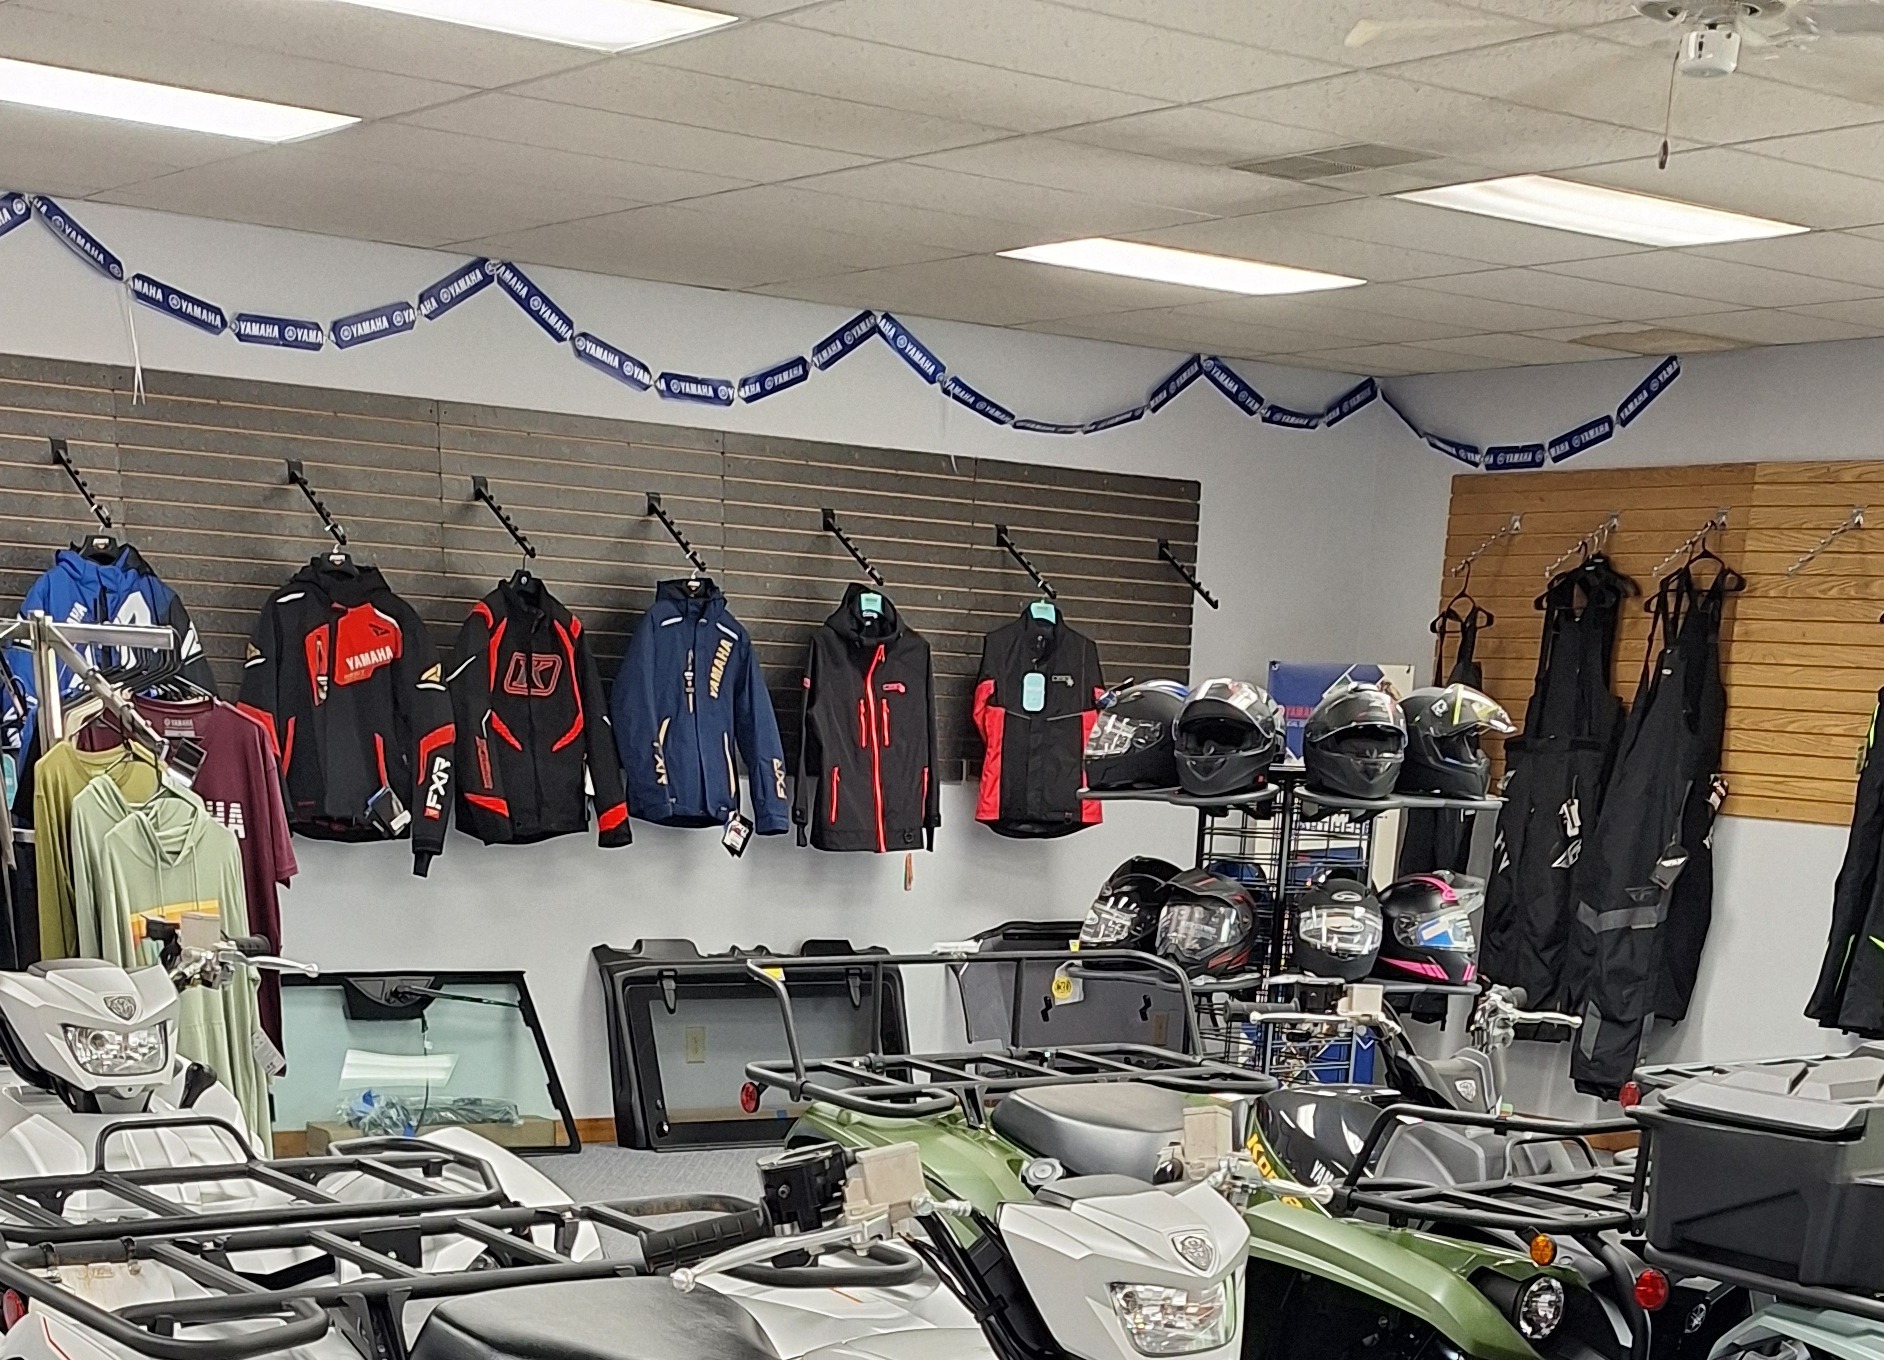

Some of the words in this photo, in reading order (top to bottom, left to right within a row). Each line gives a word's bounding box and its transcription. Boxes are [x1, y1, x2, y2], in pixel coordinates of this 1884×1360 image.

[63, 225, 105, 265] YAMAHA
[134, 277, 163, 302] MAHA
[449, 268, 484, 298] YAMAHA
[180, 299, 222, 329] YAMAHA
[351, 315, 389, 338] YAMAHA
[538, 303, 573, 340] YAMAHA
[239, 323, 279, 339] YAMAHA
[296, 328, 323, 344] YAMA
[585, 339, 620, 369] YAMAHA
[905, 342, 936, 376] YAMAHA
[773, 364, 803, 386] YAMAHA
[1210, 367, 1239, 394] YAMAHA
[680, 383, 714, 398] YAMAHA
[945, 377, 976, 405] YAMAHA
[1619, 389, 1649, 420] YAMAHA
[345, 645, 394, 671] YAMAHA
[709, 638, 734, 699] YAMAHA
[426, 756, 452, 810] FXR
[772, 757, 788, 800] FXR
